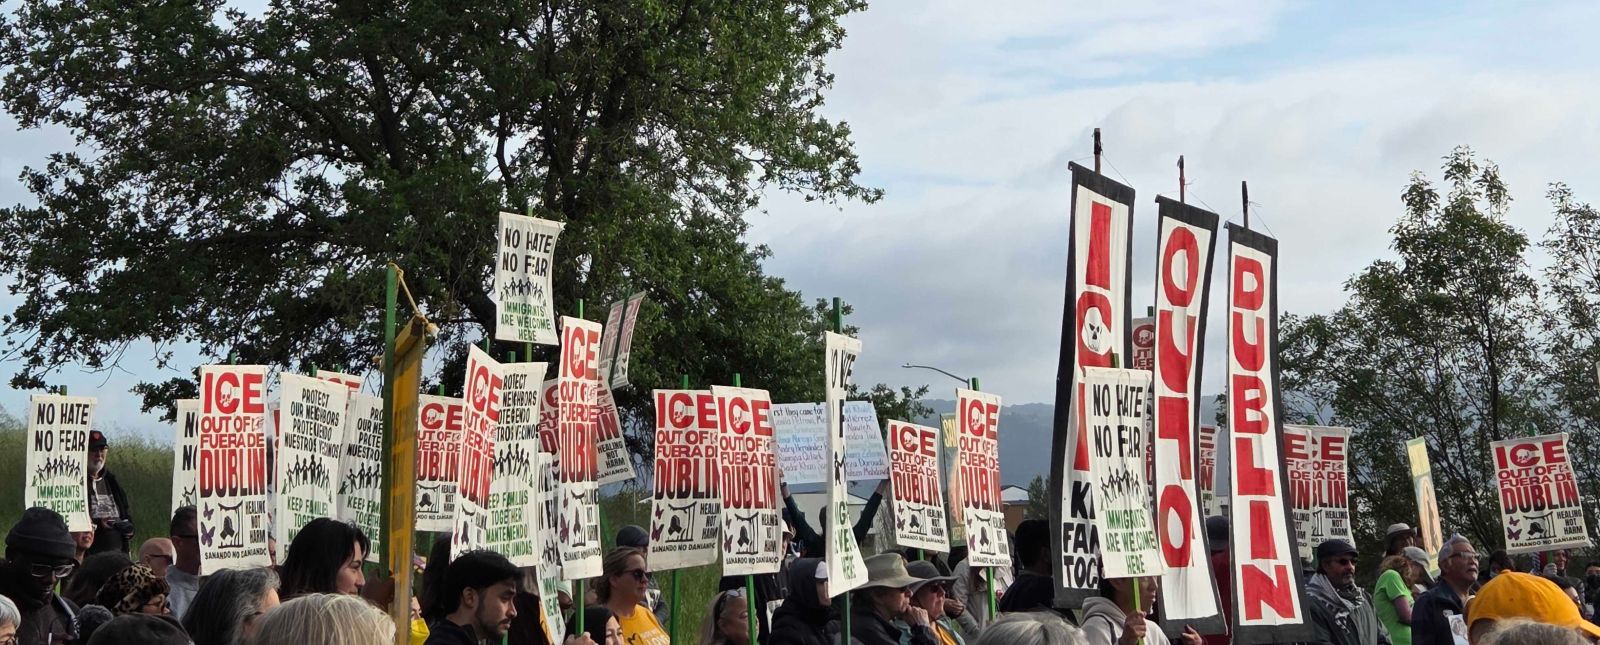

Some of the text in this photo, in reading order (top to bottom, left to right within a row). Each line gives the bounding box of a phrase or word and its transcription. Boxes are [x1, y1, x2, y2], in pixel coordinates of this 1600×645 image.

[505, 227, 553, 253] NO HATE
[502, 251, 518, 272] NO
[501, 314, 551, 331] ARE WELCOME
[562, 326, 599, 380] ICE
[467, 358, 503, 422] ICE
[503, 373, 527, 390] ROTECT
[204, 372, 264, 414] ICE
[302, 388, 330, 408] PROTECT
[561, 381, 580, 402] OUT
[290, 401, 304, 418] OUR
[1093, 384, 1143, 418] NO HATE
[36, 403, 89, 425] NO HATE
[421, 403, 463, 431] CE
[561, 403, 584, 422] FUER
[658, 392, 718, 429] ICE
[717, 396, 773, 436] ICE
[774, 407, 783, 416] rst
[960, 397, 999, 440] ICE
[201, 416, 251, 433] OUT OF
[357, 418, 372, 432] OUR
[35, 430, 86, 452] NO FEAR
[200, 433, 265, 449] FUERA DE
[418, 430, 451, 441] UT OF
[497, 425, 514, 442] TROS
[657, 430, 708, 445] OUT OF
[890, 424, 936, 457] ICE
[1094, 424, 1112, 458] NO
[1233, 254, 1295, 621] DUBLIN
[346, 443, 383, 462] NUESTRO
[418, 441, 461, 452] ERA DE
[656, 445, 702, 458] FUERA
[720, 436, 763, 452] OUT OF
[959, 436, 980, 452] OUT
[606, 450, 618, 459] NOT
[720, 451, 776, 467] FUERA DE
[890, 451, 914, 464] OUT
[914, 454, 928, 466] OF
[1495, 440, 1566, 469] ICE
[200, 448, 265, 498] DUBLIN
[417, 451, 460, 482] UBLIN
[891, 462, 937, 478] FUERA DE
[1312, 461, 1330, 471] OF
[1498, 464, 1557, 480] OUT OF
[1290, 470, 1310, 481] DE
[1327, 471, 1345, 480] DE
[1500, 472, 1573, 488] FUERA DE
[37, 485, 80, 498] IMMGRANTS
[441, 485, 457, 493] HEALIN
[721, 465, 777, 509] DUBLIN
[892, 471, 941, 508] DUBLIN
[960, 466, 1002, 512] DUBIN
[1313, 480, 1346, 508] BLIN
[51, 500, 85, 512] WELCOME
[287, 496, 303, 511] KEEP
[489, 493, 499, 509] EEP
[1501, 481, 1580, 514] DUBLIN
[700, 503, 720, 515] HEALIN
[1325, 510, 1348, 519] HEALING
[1557, 509, 1583, 520] HEALING
[705, 515, 717, 527] NOT
[1565, 518, 1577, 526] NOT
[1330, 528, 1348, 536] HARM
[1564, 526, 1583, 535] HARM
[1106, 532, 1120, 553] ARE
[1063, 556, 1099, 589] TOG
[1127, 554, 1146, 575] HERE
